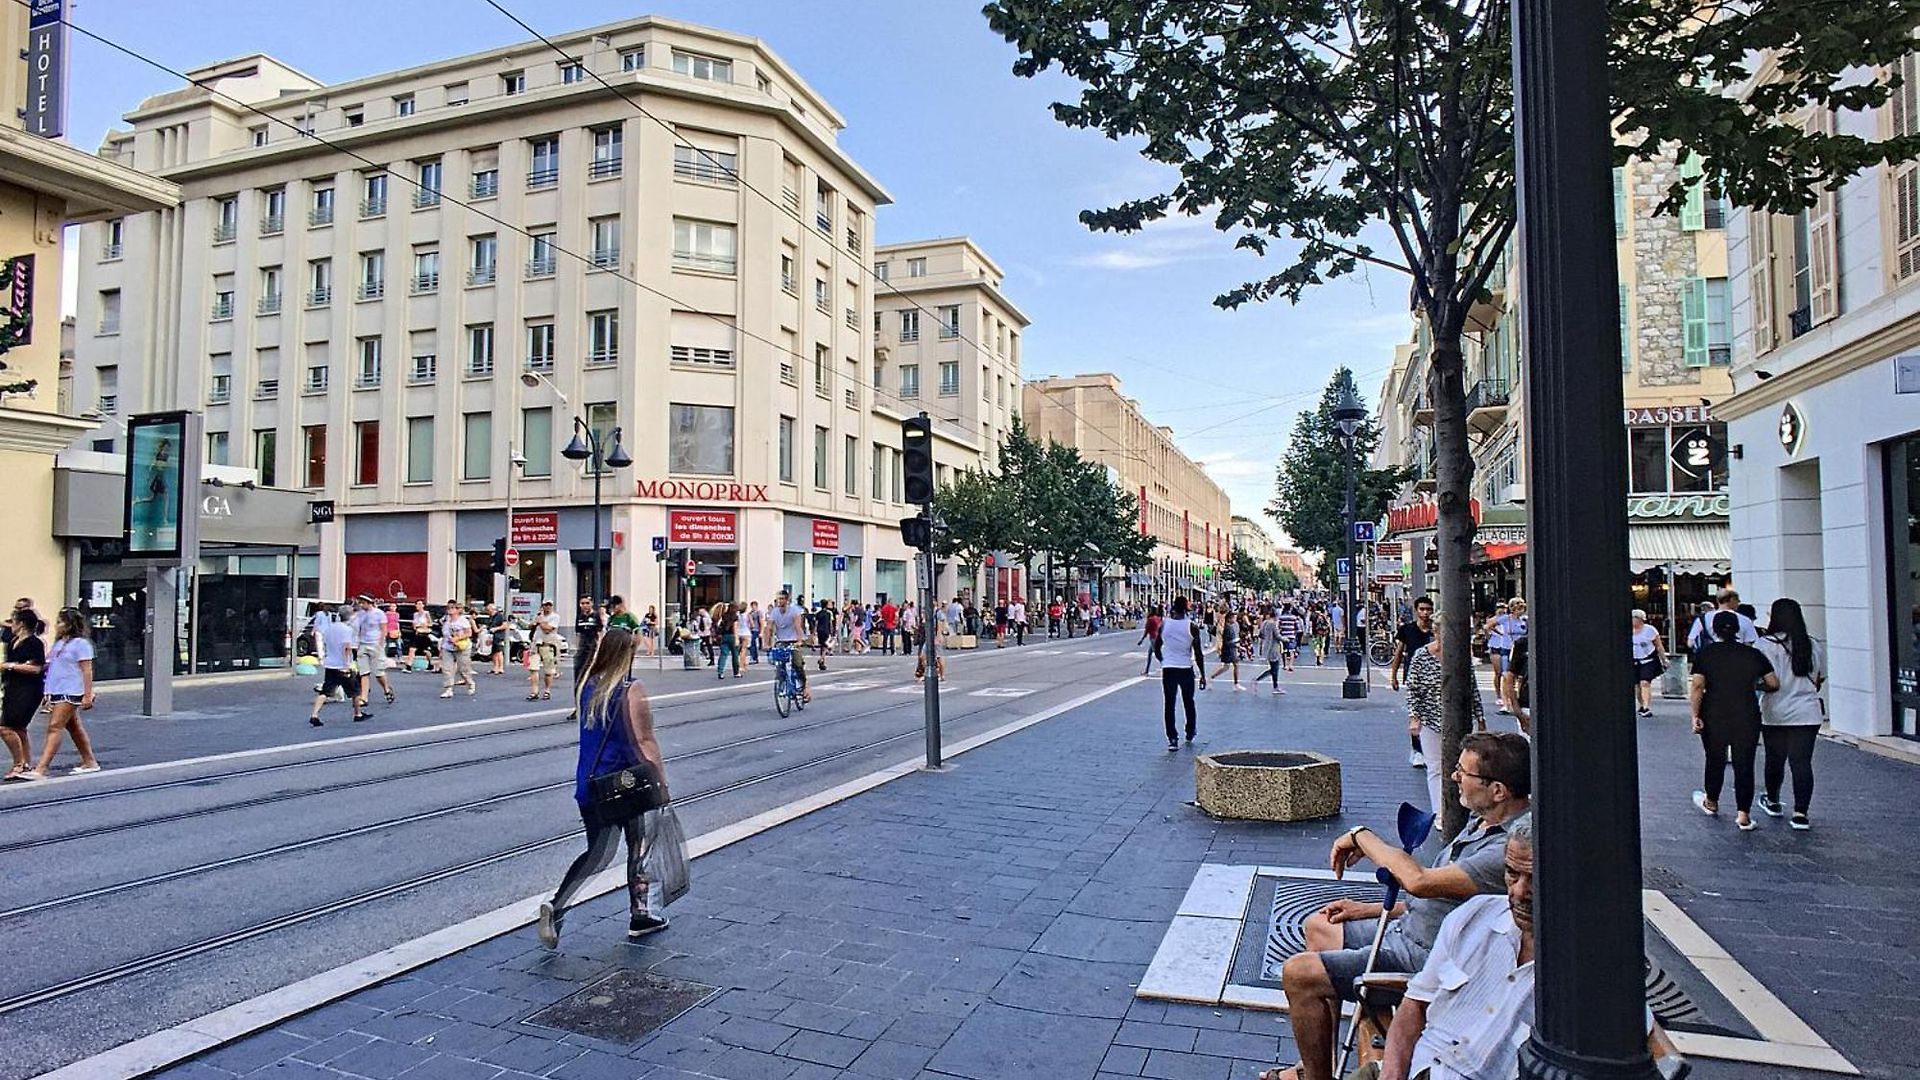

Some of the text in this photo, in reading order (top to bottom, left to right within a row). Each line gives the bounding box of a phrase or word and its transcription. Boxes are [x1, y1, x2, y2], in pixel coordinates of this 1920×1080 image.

[38, 33, 50, 132] HOTEL
[637, 480, 770, 502] MONOPRIX
[708, 515, 726, 523] tous
[688, 523, 731, 531] dimanches
